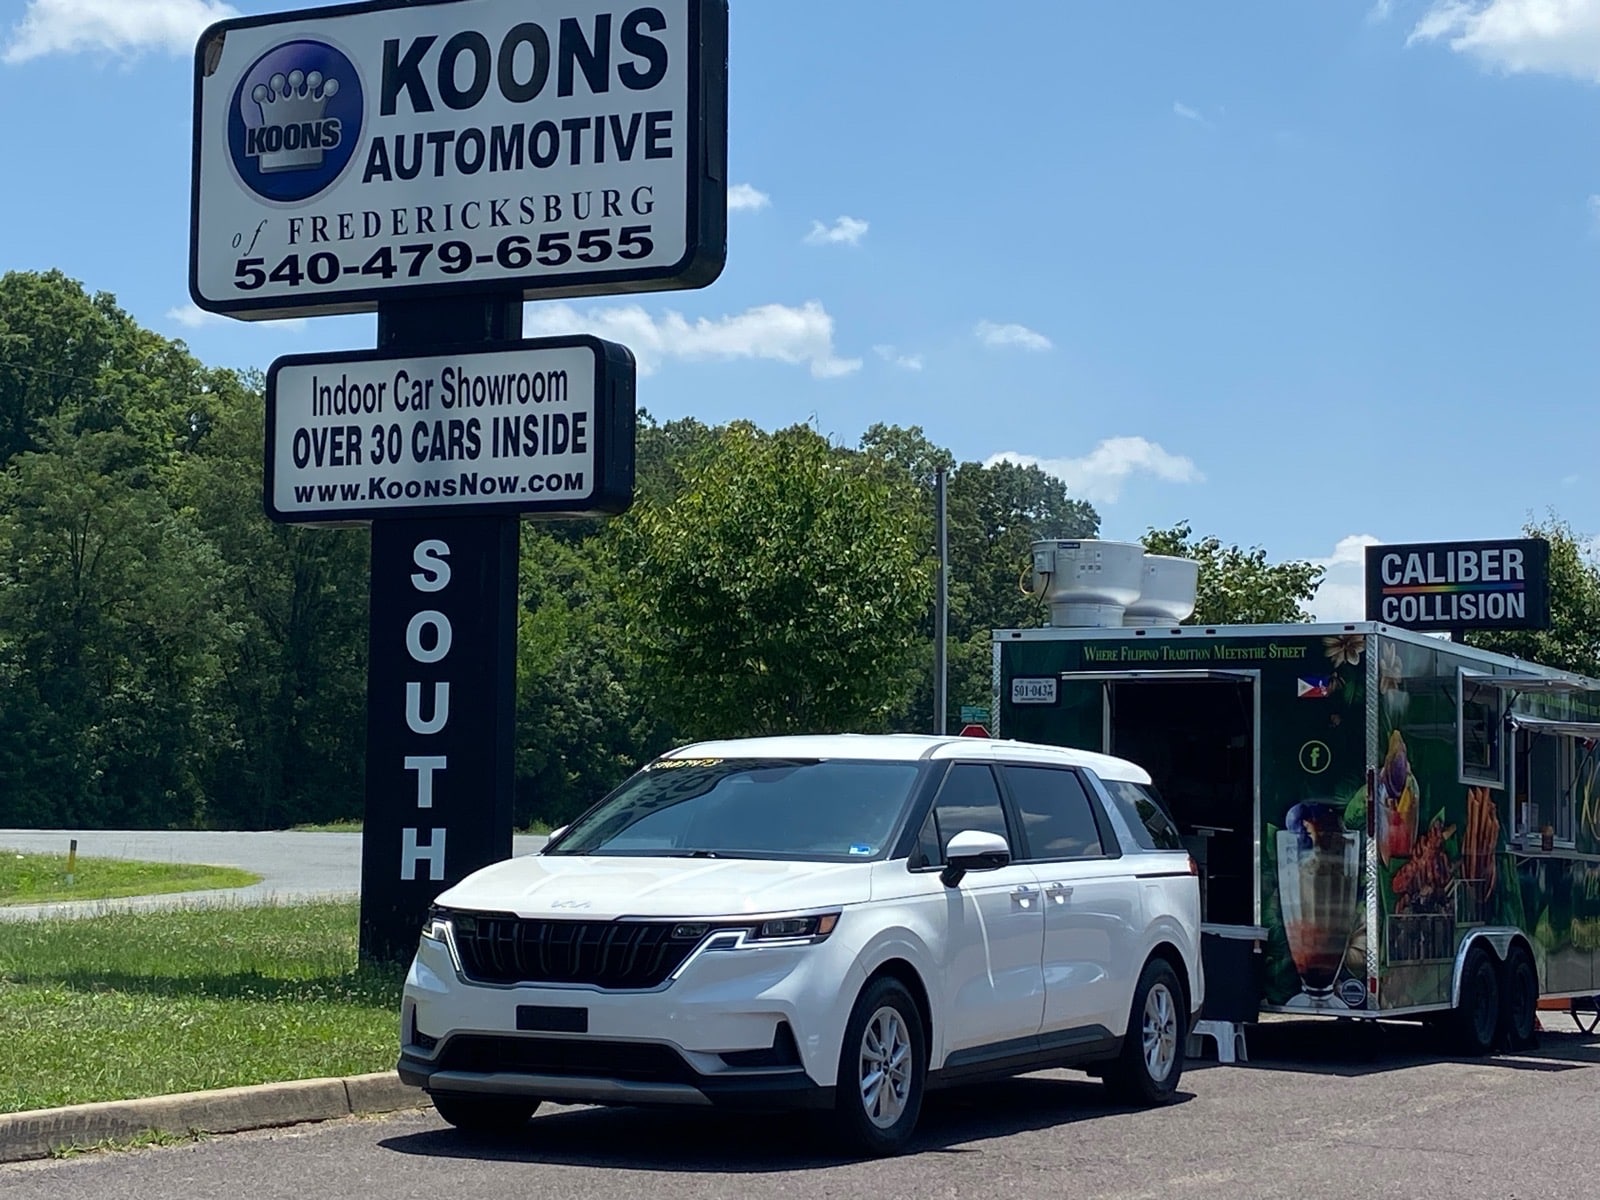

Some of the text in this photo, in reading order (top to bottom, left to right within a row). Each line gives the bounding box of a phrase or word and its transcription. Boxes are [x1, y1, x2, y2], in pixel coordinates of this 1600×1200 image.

[379, 6, 668, 116] KOONS
[247, 118, 341, 154] KOONS
[361, 110, 673, 184] AUTOMOTIVE
[231, 185, 655, 256] of FREDERICKSBURG
[233, 224, 655, 291] 540-479-6555
[312, 366, 568, 417] Indoor Car Showroom
[292, 411, 587, 469] OVER 30 CARS INSIDE
[1381, 549, 1525, 586] CALIBER
[1382, 592, 1525, 623] COLLISION
[1084, 646, 1118, 661] WHERE
[1121, 646, 1159, 661] FILIPINO
[1160, 645, 1210, 660] TRADITION
[1269, 643, 1307, 658] STREET
[400, 539, 452, 880] SOUTH
